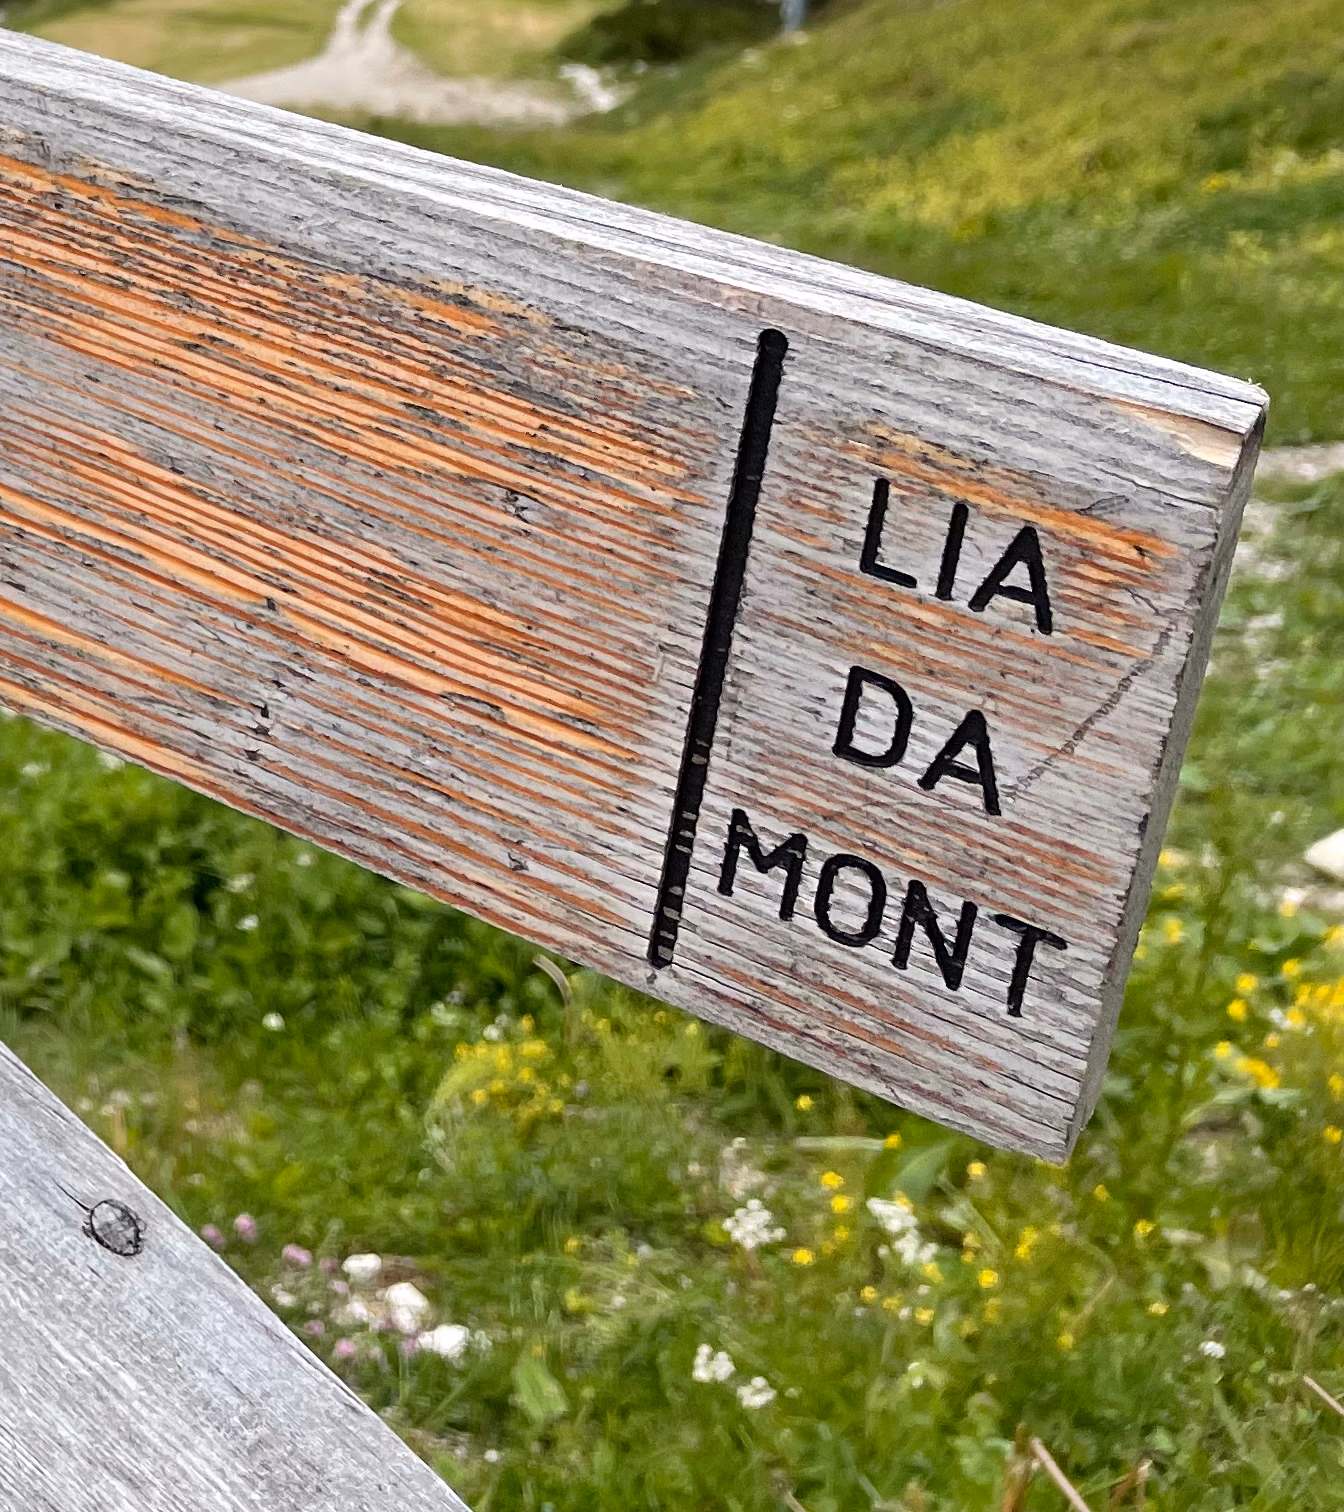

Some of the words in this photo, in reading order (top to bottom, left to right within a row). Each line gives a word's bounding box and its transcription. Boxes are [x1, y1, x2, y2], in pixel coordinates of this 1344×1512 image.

[859, 477, 1054, 636] LIA
[832, 665, 1002, 816] DA
[716, 807, 1069, 1018] MONT
